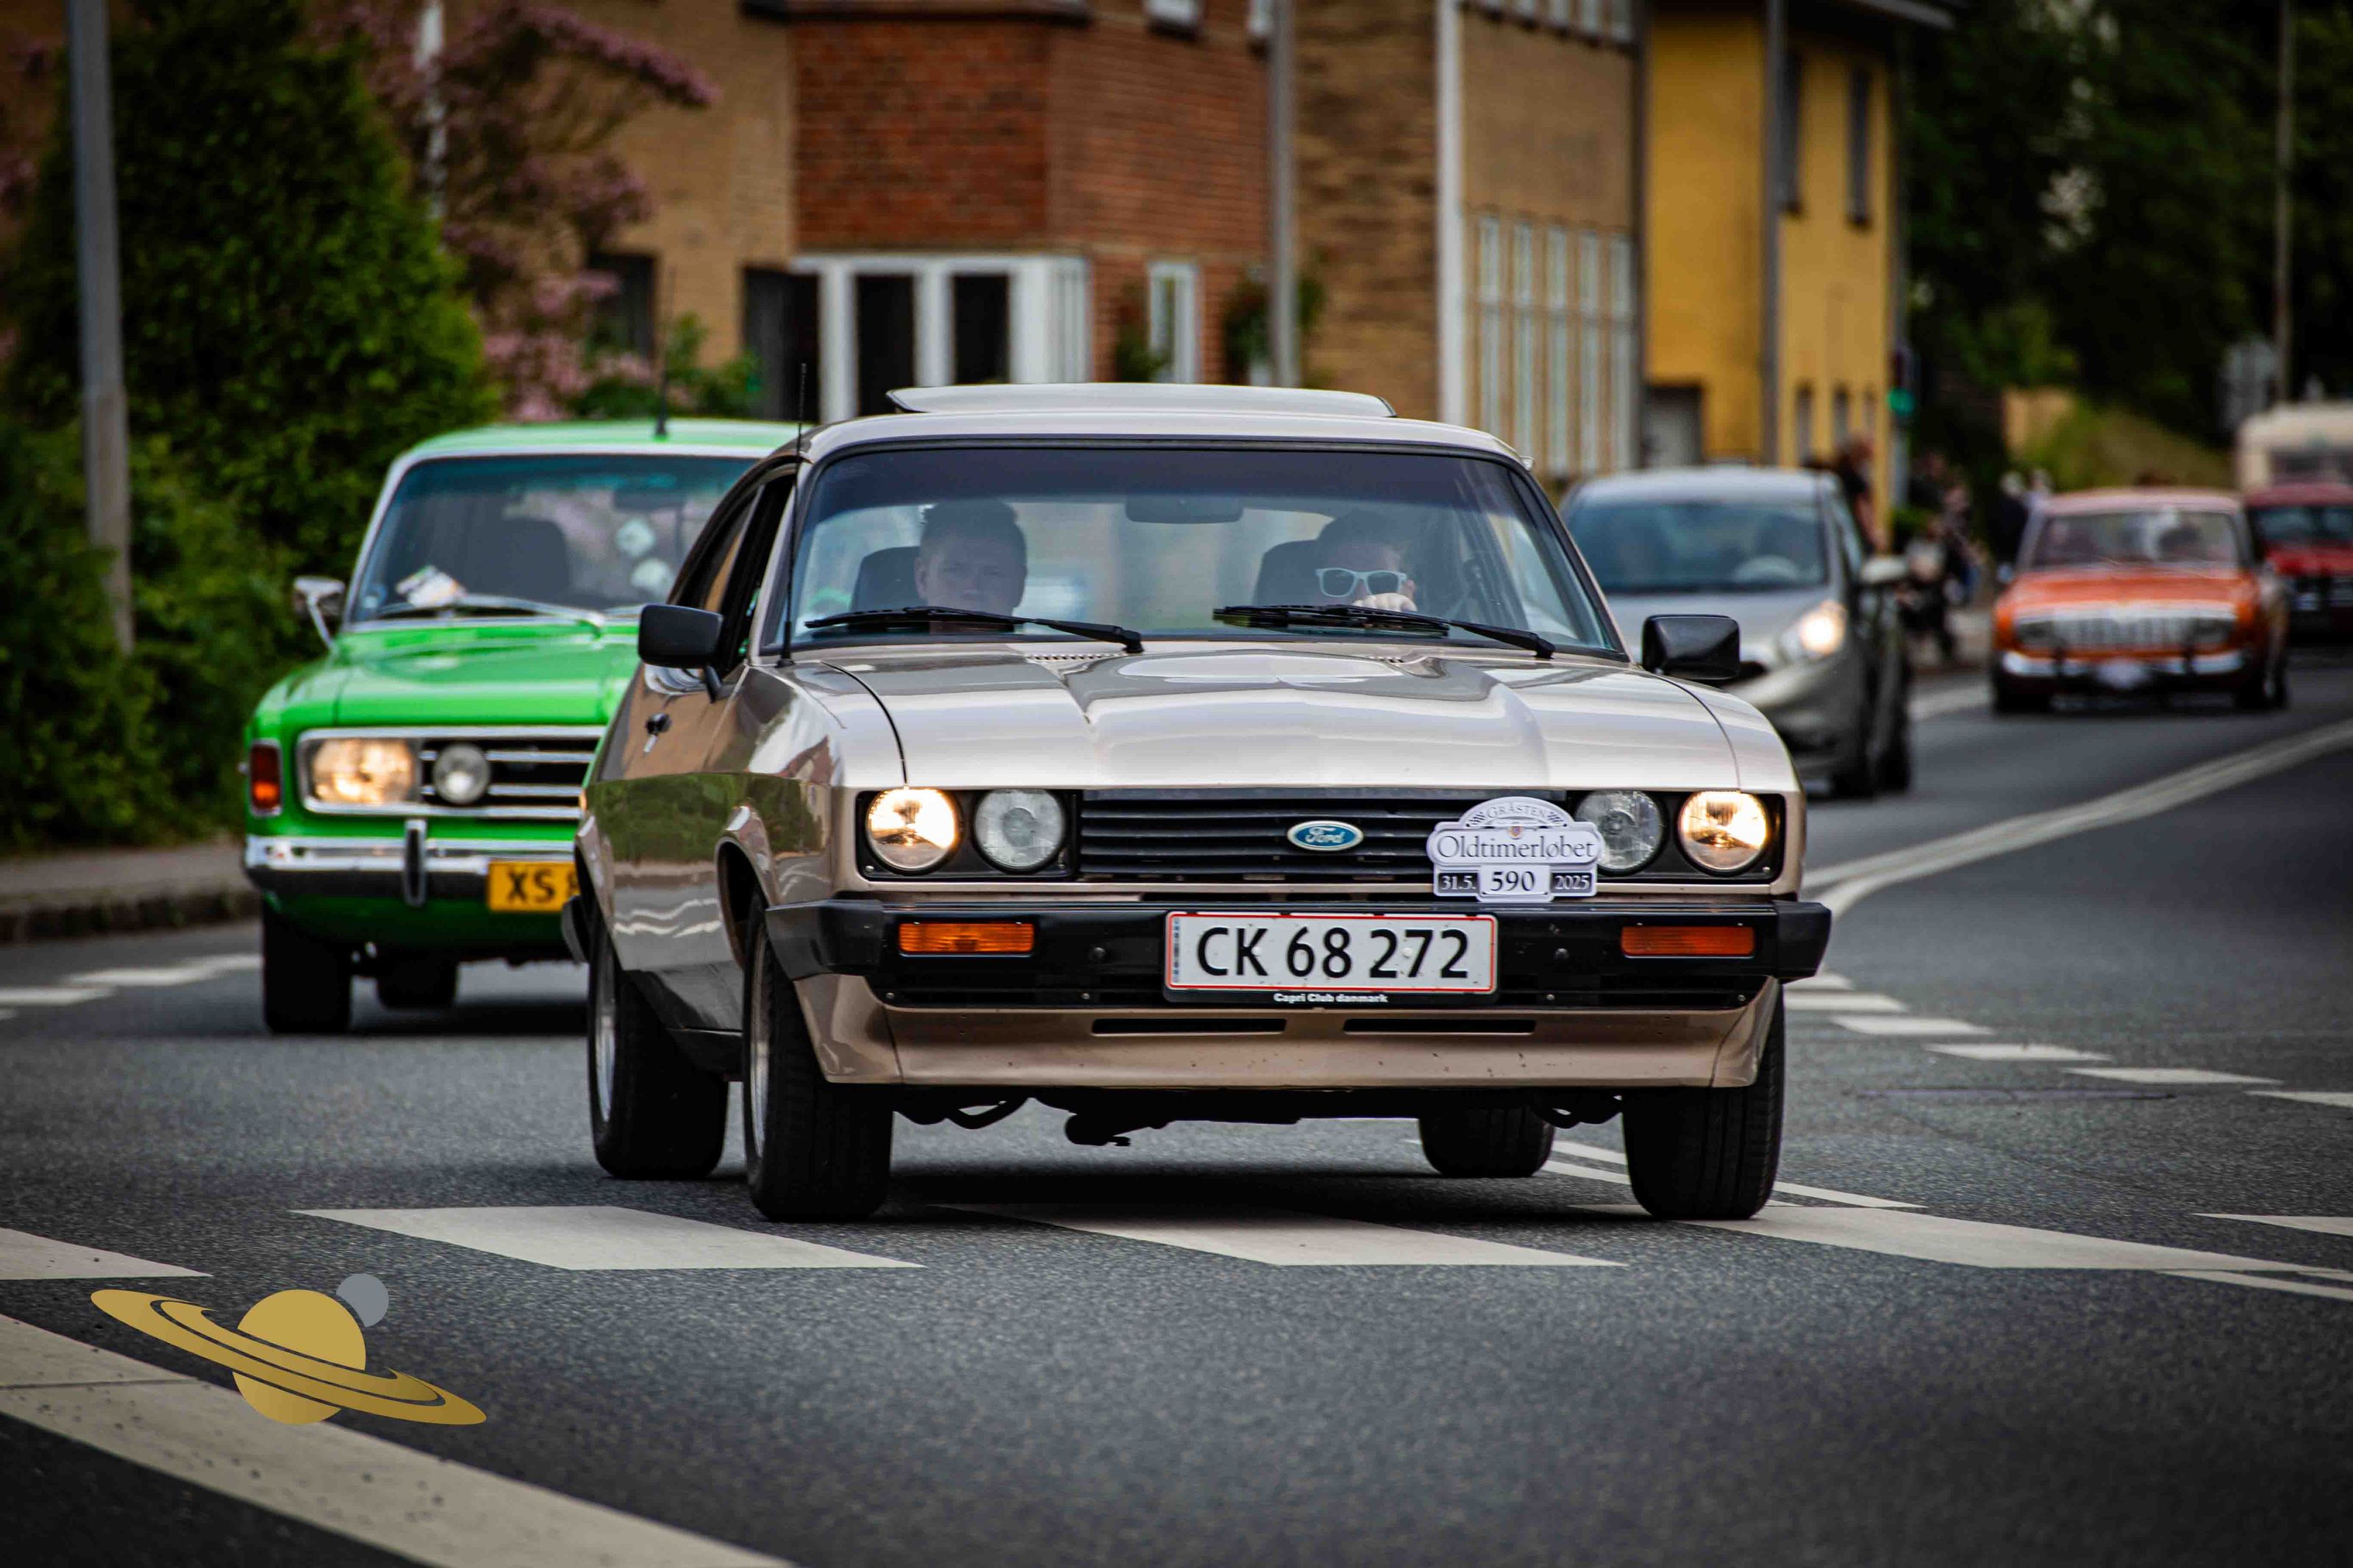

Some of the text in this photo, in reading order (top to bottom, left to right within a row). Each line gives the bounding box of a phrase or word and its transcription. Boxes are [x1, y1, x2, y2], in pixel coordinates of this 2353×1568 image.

[1304, 826, 1346, 843] Ford
[1437, 835, 1595, 859] Oldtimerløbet
[507, 868, 556, 904] XS
[1490, 870, 1535, 892] 590
[1554, 875, 1590, 890] 2025
[1197, 926, 1268, 977] CK
[1286, 926, 1352, 978] 68
[1369, 928, 1469, 979] 272
[1274, 992, 1388, 1004] Capri Club danmark
